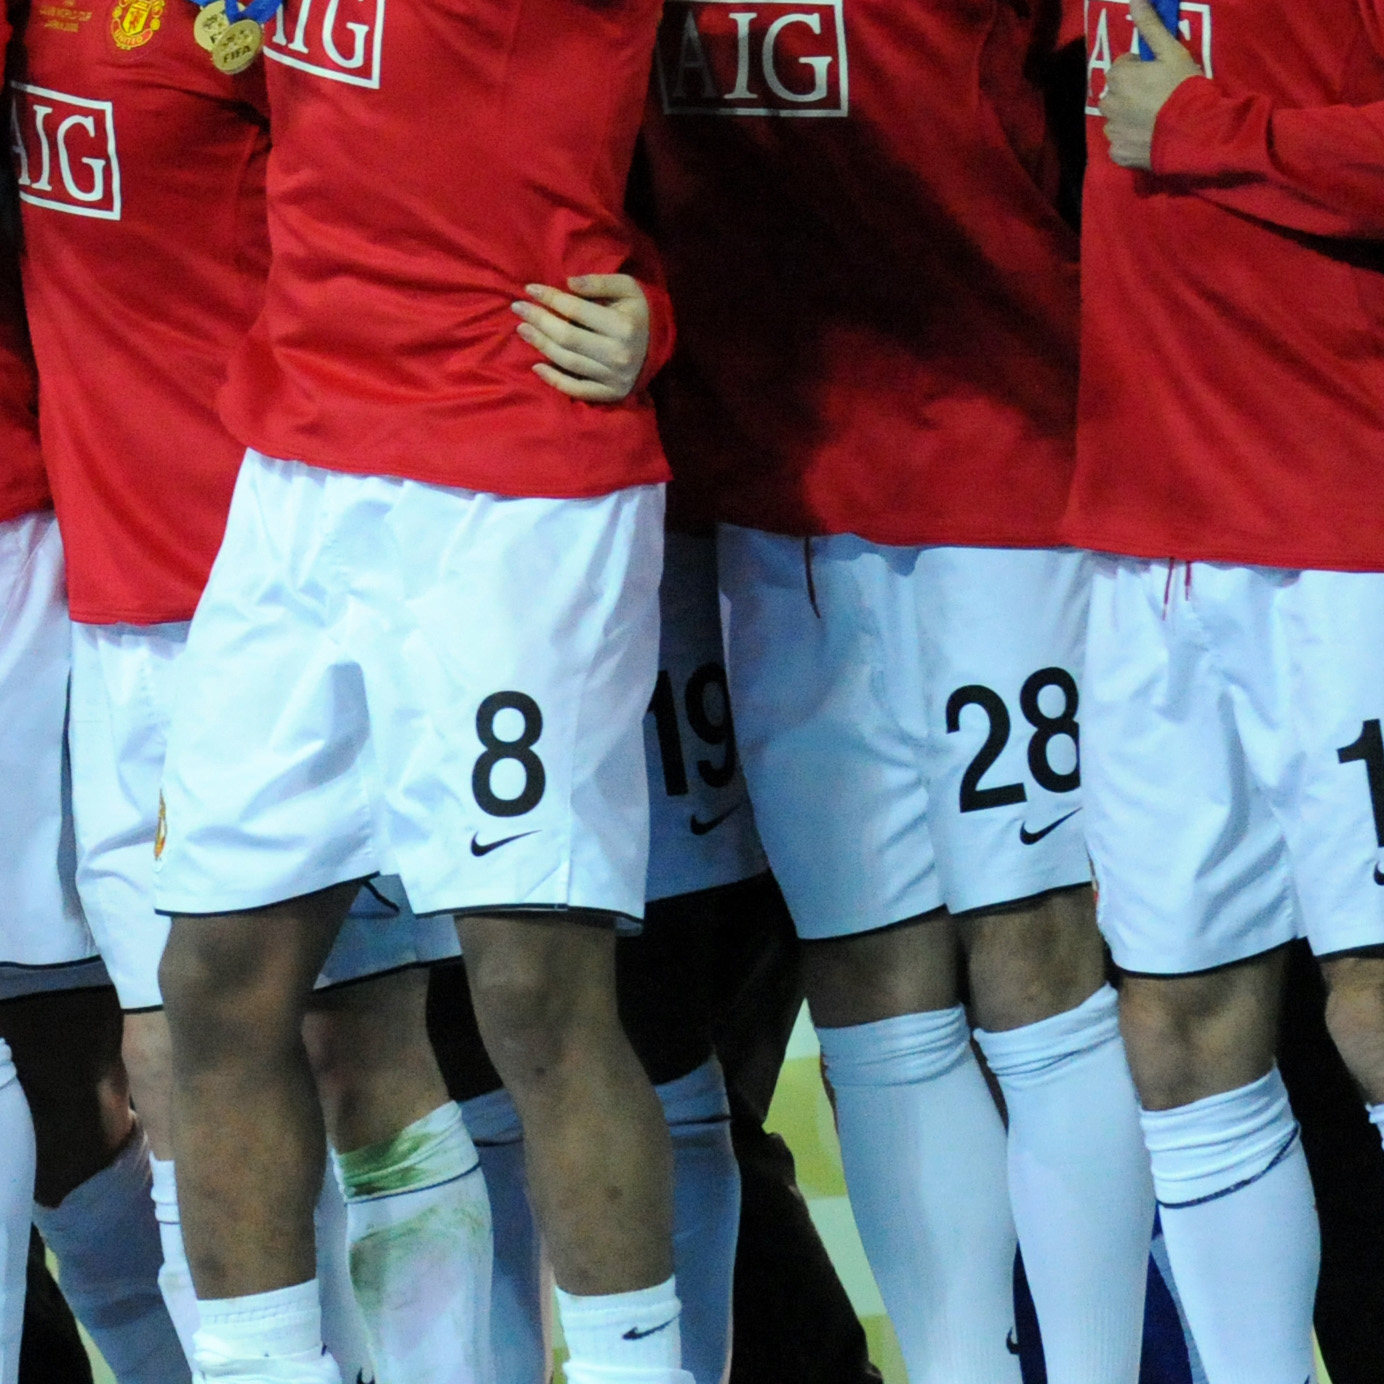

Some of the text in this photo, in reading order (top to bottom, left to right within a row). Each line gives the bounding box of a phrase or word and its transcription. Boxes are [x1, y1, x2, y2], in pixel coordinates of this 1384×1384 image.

[223, 45, 251, 64] FIFA
[671, 11, 833, 103] AIG
[472, 690, 546, 818] 8
[647, 662, 738, 796] 19
[945, 667, 1081, 814] 28
